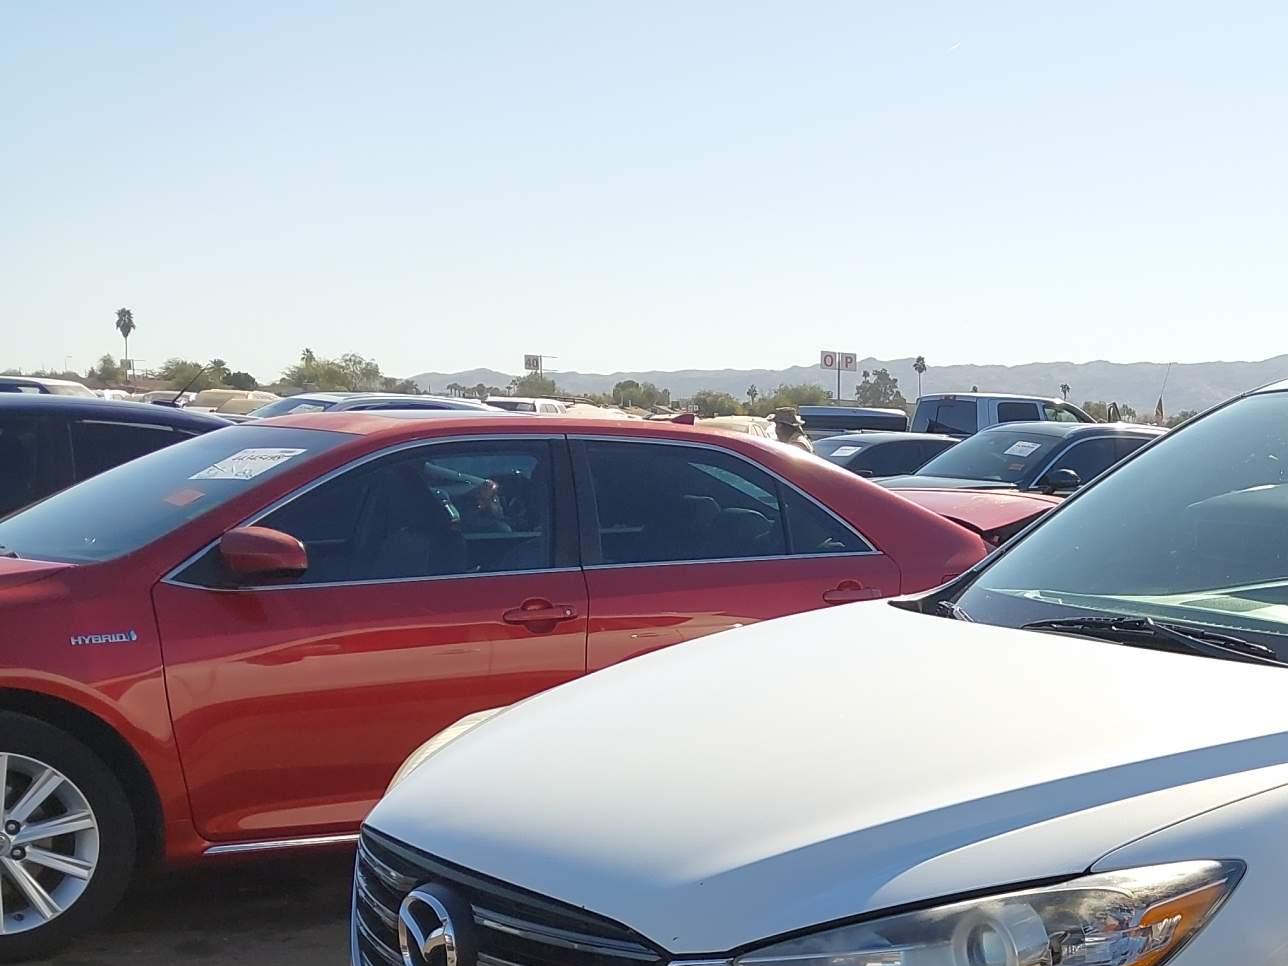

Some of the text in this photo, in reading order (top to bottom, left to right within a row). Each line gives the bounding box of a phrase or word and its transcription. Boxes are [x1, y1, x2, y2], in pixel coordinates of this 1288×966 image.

[823, 354, 853, 369] O P
[70, 633, 128, 646] HYBRID
